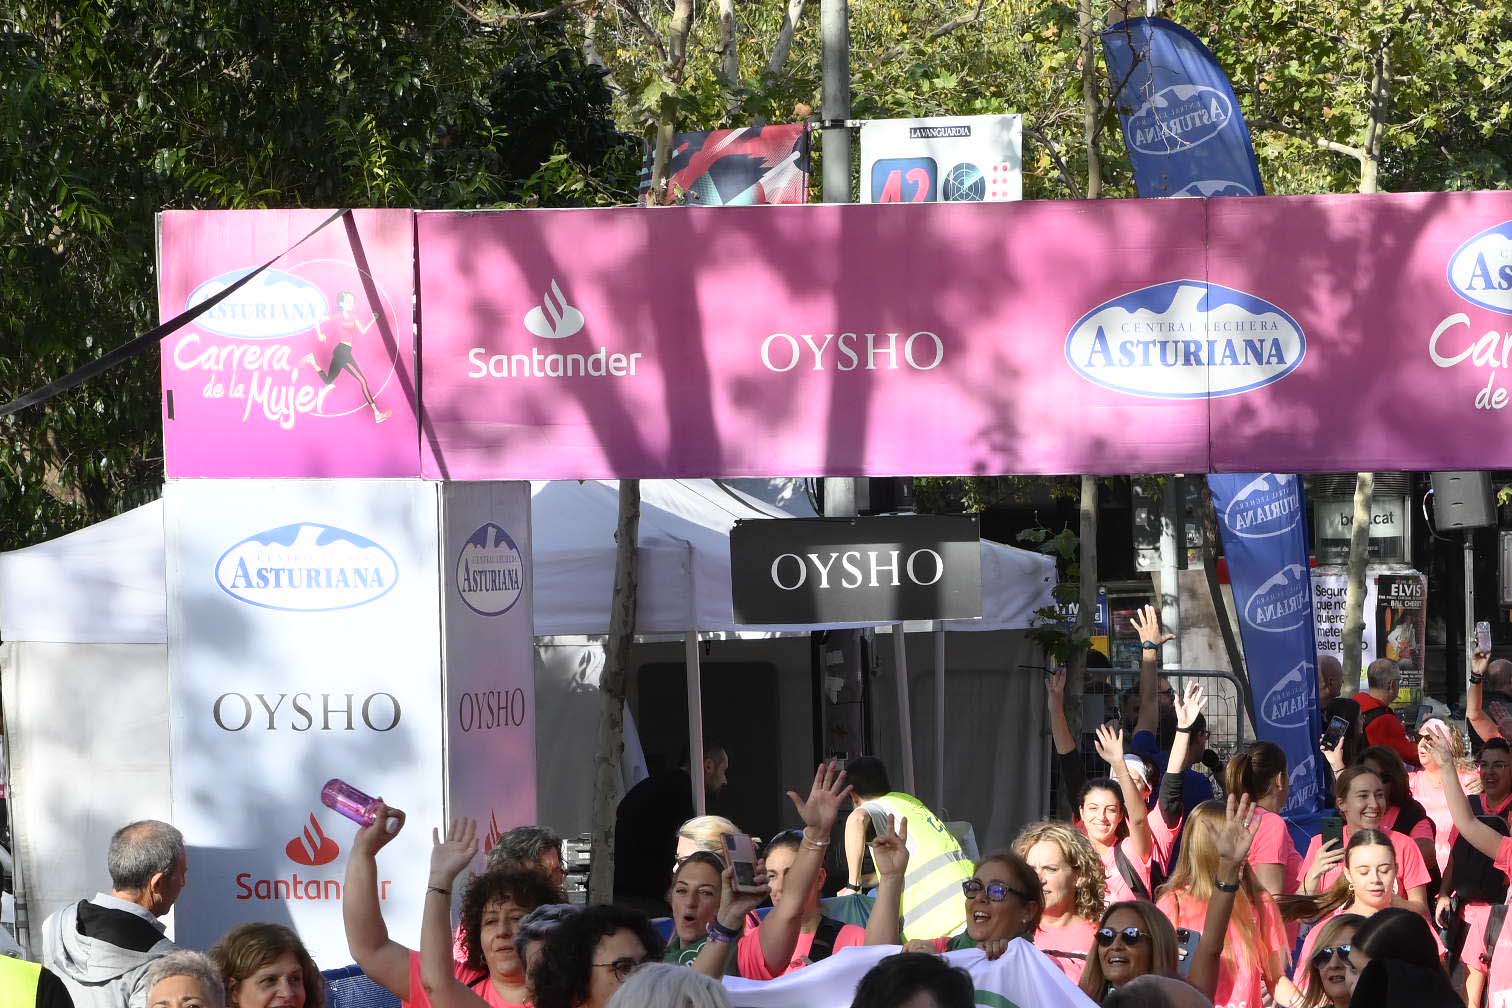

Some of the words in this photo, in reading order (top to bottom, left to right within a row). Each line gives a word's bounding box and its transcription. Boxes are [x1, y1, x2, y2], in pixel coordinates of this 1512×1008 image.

[1121, 320, 1193, 333] CENTRAL
[173, 333, 293, 372] Carrera
[468, 347, 643, 378] Santander
[760, 331, 945, 373] OYSHO
[1084, 325, 1288, 368] ASTURIANA
[203, 373, 225, 399] de
[229, 368, 246, 399] la
[242, 367, 336, 429] Mujer
[1475, 371, 1509, 411] de
[1340, 511, 1394, 527] b.cat
[231, 556, 386, 589] ASTURIANA
[462, 559, 520, 594] ASTURIANA
[770, 548, 944, 591] OYSHO
[1316, 602, 1333, 613] que
[1391, 583, 1422, 597] ELVIS
[1317, 641, 1336, 652] este
[213, 692, 401, 732] OYSHO
[459, 687, 525, 732] OYSHO
[236, 872, 391, 901] Santanr
